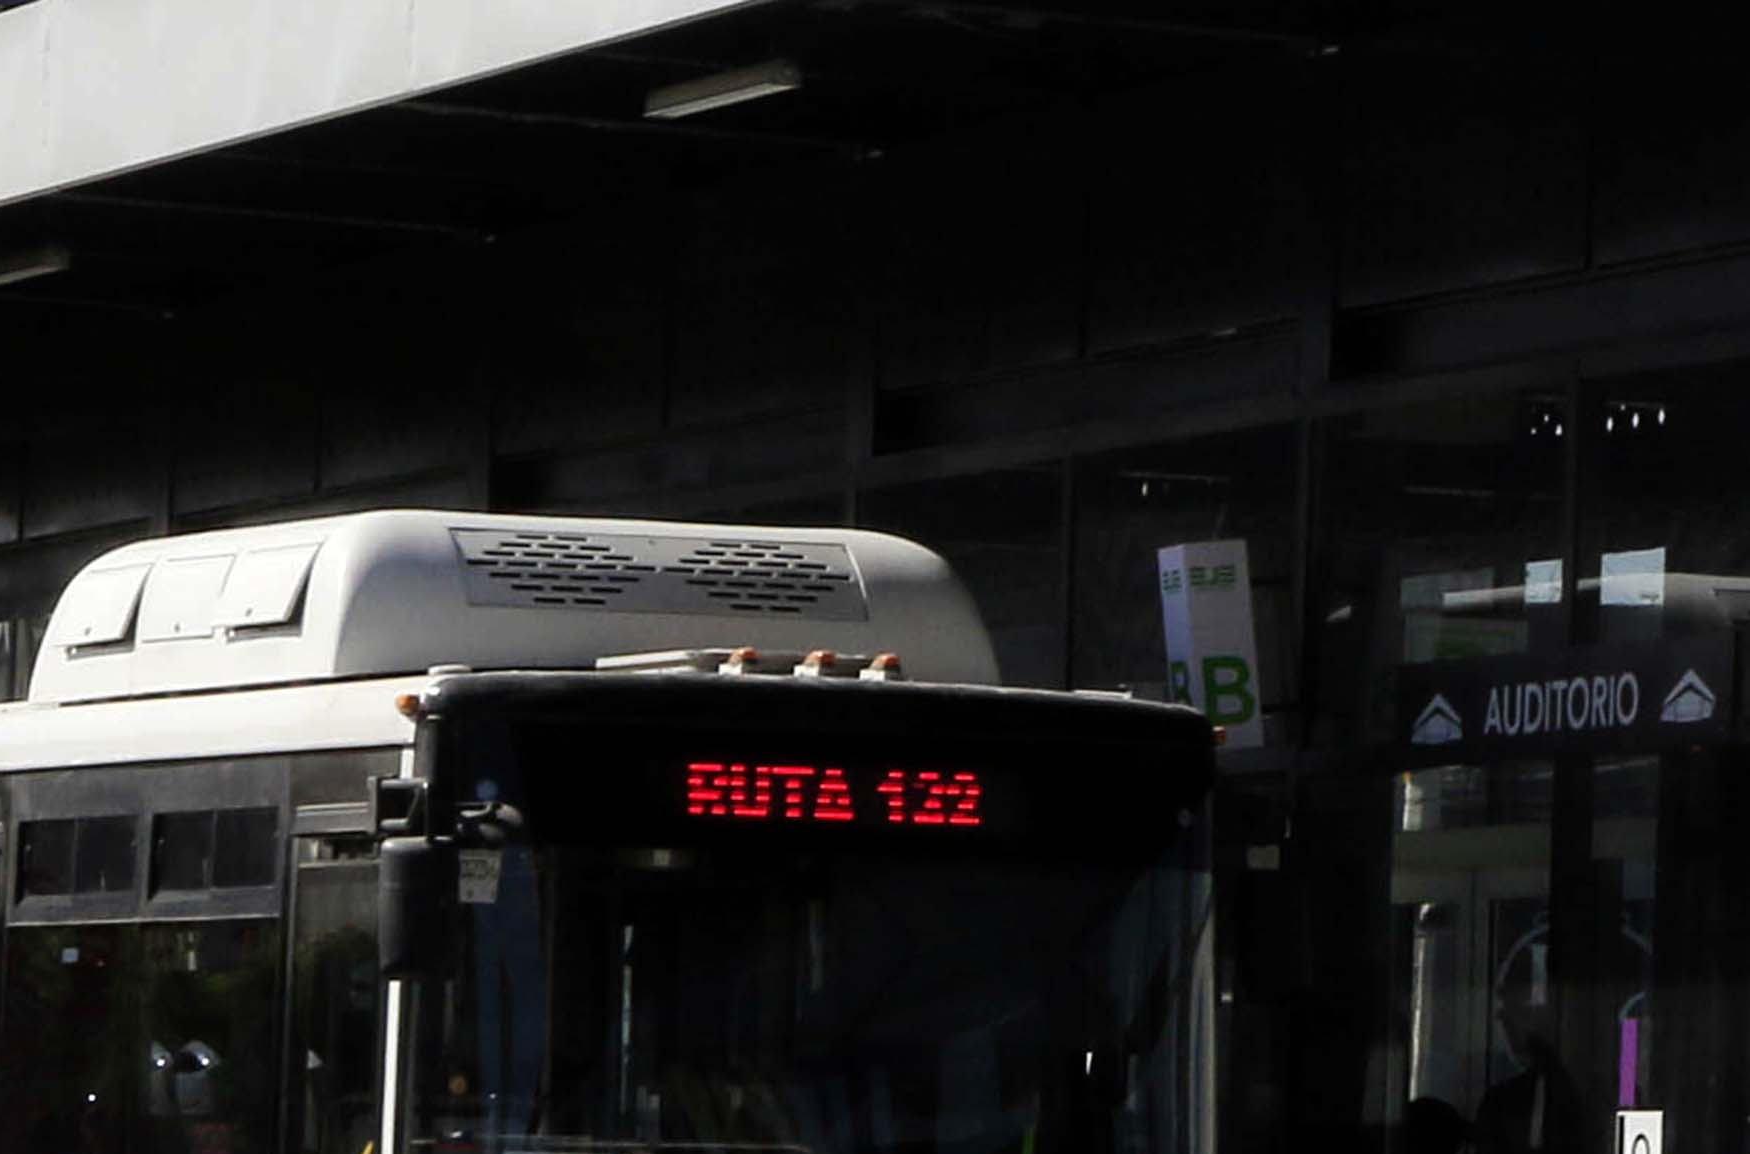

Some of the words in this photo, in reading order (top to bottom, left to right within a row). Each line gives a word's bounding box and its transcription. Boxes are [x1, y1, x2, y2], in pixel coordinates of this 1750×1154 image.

[1203, 656, 1256, 724] B
[1483, 671, 1640, 736] AUDITORIO
[687, 763, 854, 821] RUTA
